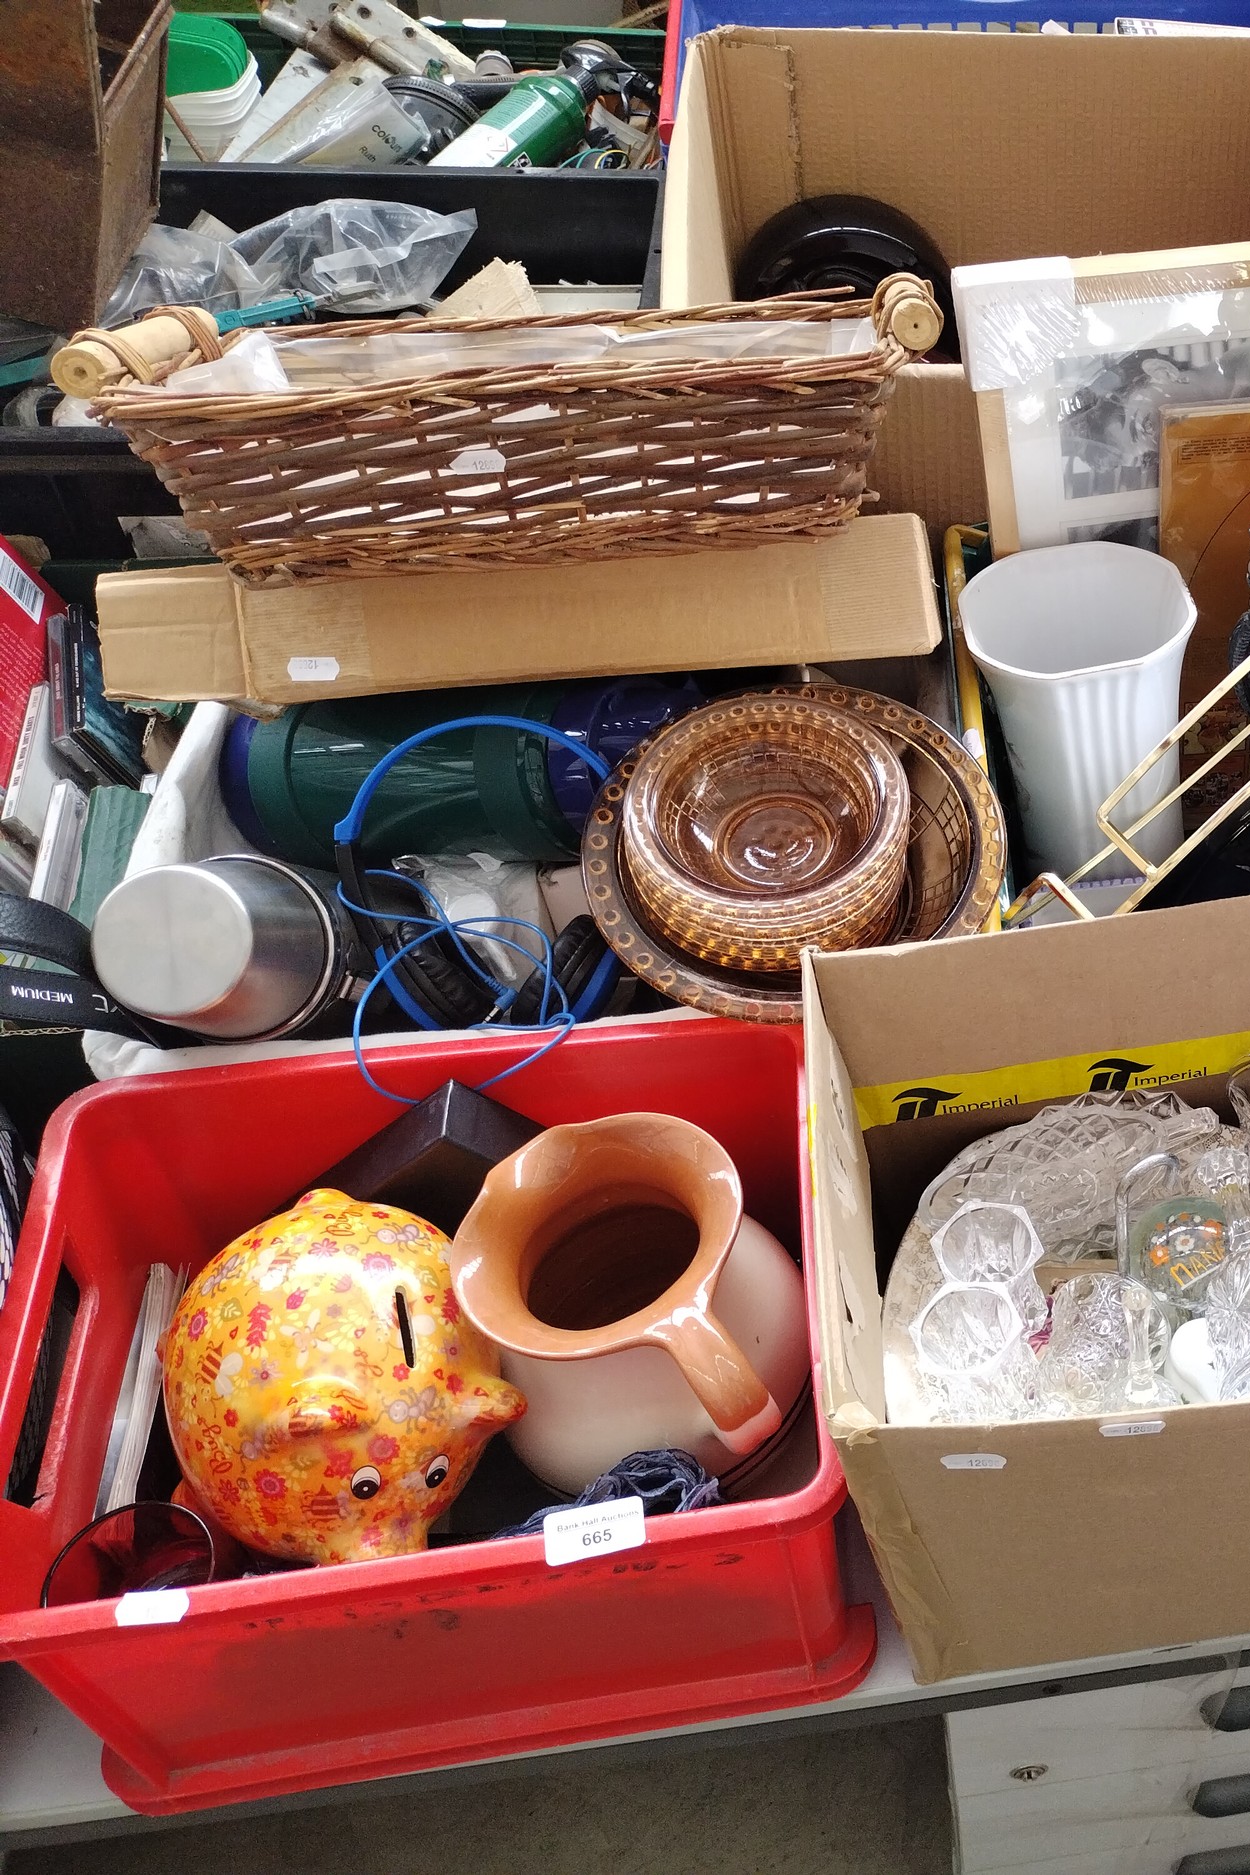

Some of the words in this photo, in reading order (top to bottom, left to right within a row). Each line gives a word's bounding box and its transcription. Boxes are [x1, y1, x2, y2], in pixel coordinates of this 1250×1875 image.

[359, 145, 377, 163] Ruth
[10, 984, 74, 1004] MEDIUM
[1133, 1066, 1208, 1088] Imperial
[942, 1094, 1020, 1115] Imperial
[556, 1522, 580, 1533] Bank
[581, 1517, 599, 1527] Hall
[601, 1510, 639, 1522] Auctions
[582, 1528, 613, 1547] 665
